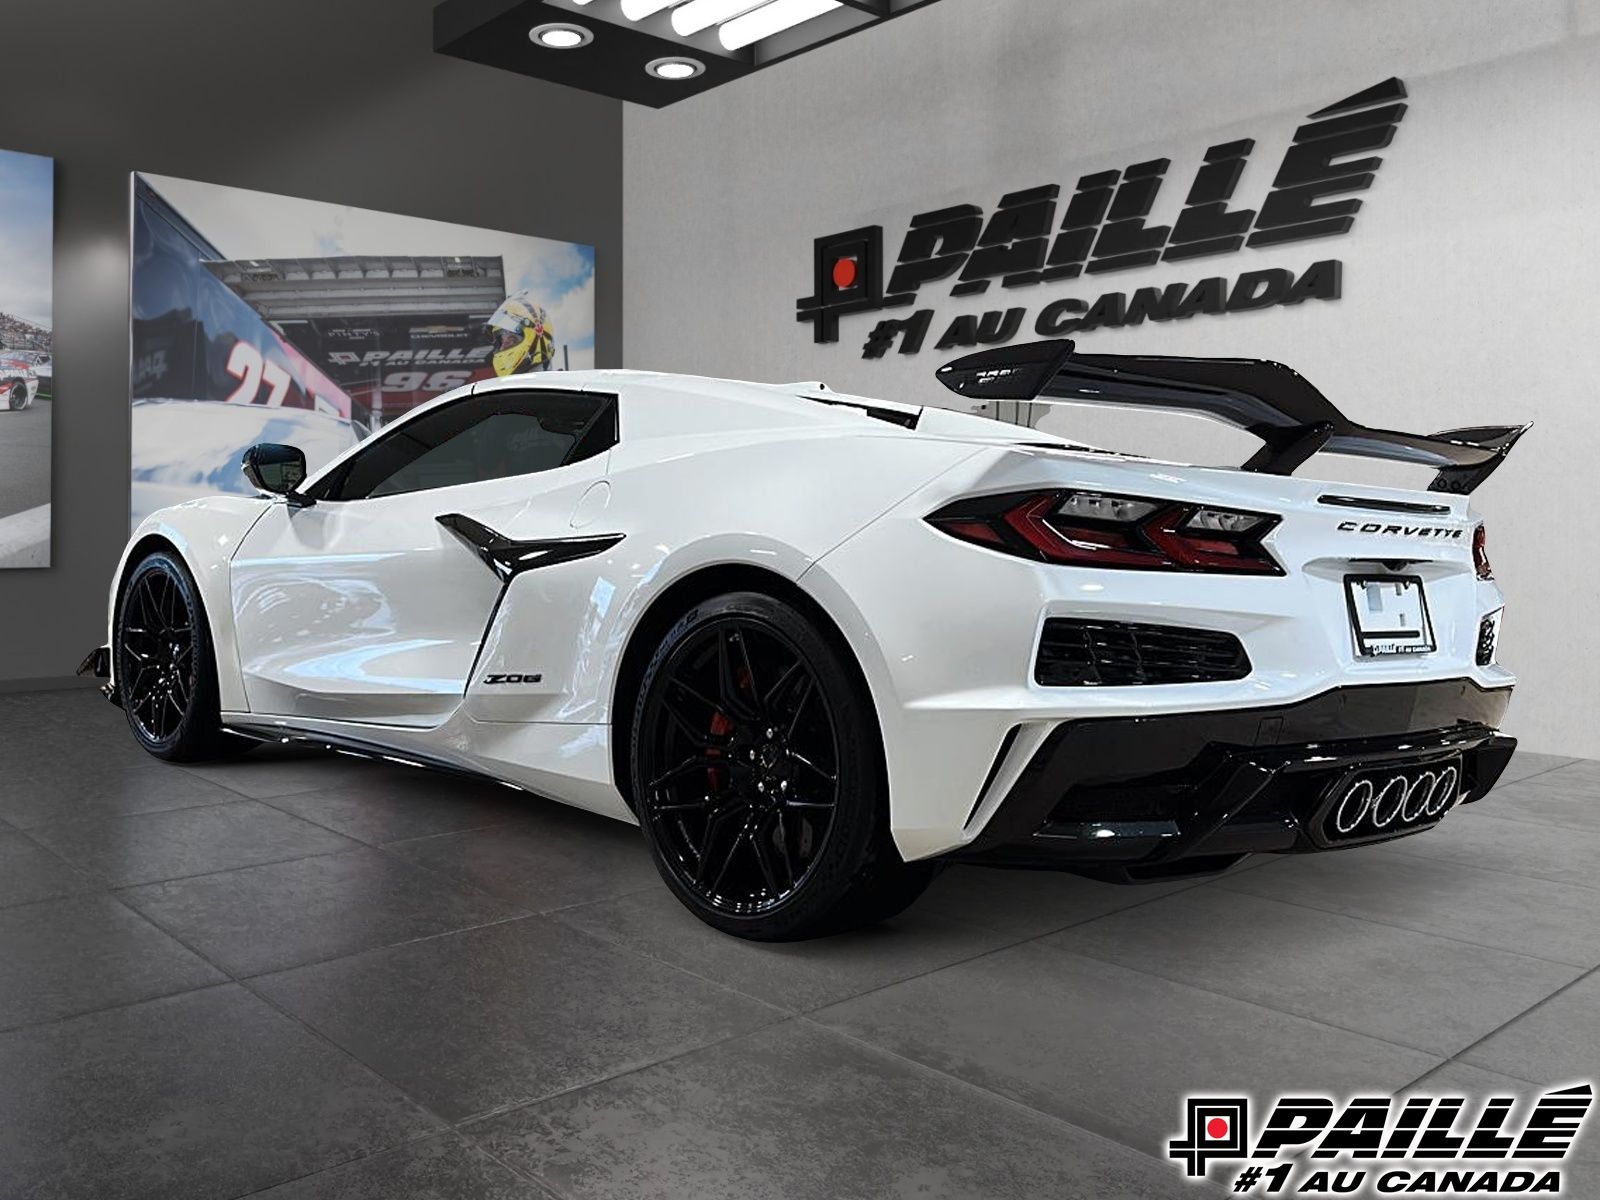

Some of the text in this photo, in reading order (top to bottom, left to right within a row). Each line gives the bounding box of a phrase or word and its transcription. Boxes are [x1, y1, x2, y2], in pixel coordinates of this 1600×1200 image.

[886, 77, 1408, 297] PAILLÉ
[862, 259, 1342, 360] #1 AU CANADA
[225, 341, 291, 407] 27
[381, 371, 472, 393] 96
[1337, 521, 1463, 538] CORVETTE
[483, 674, 542, 684] Z06
